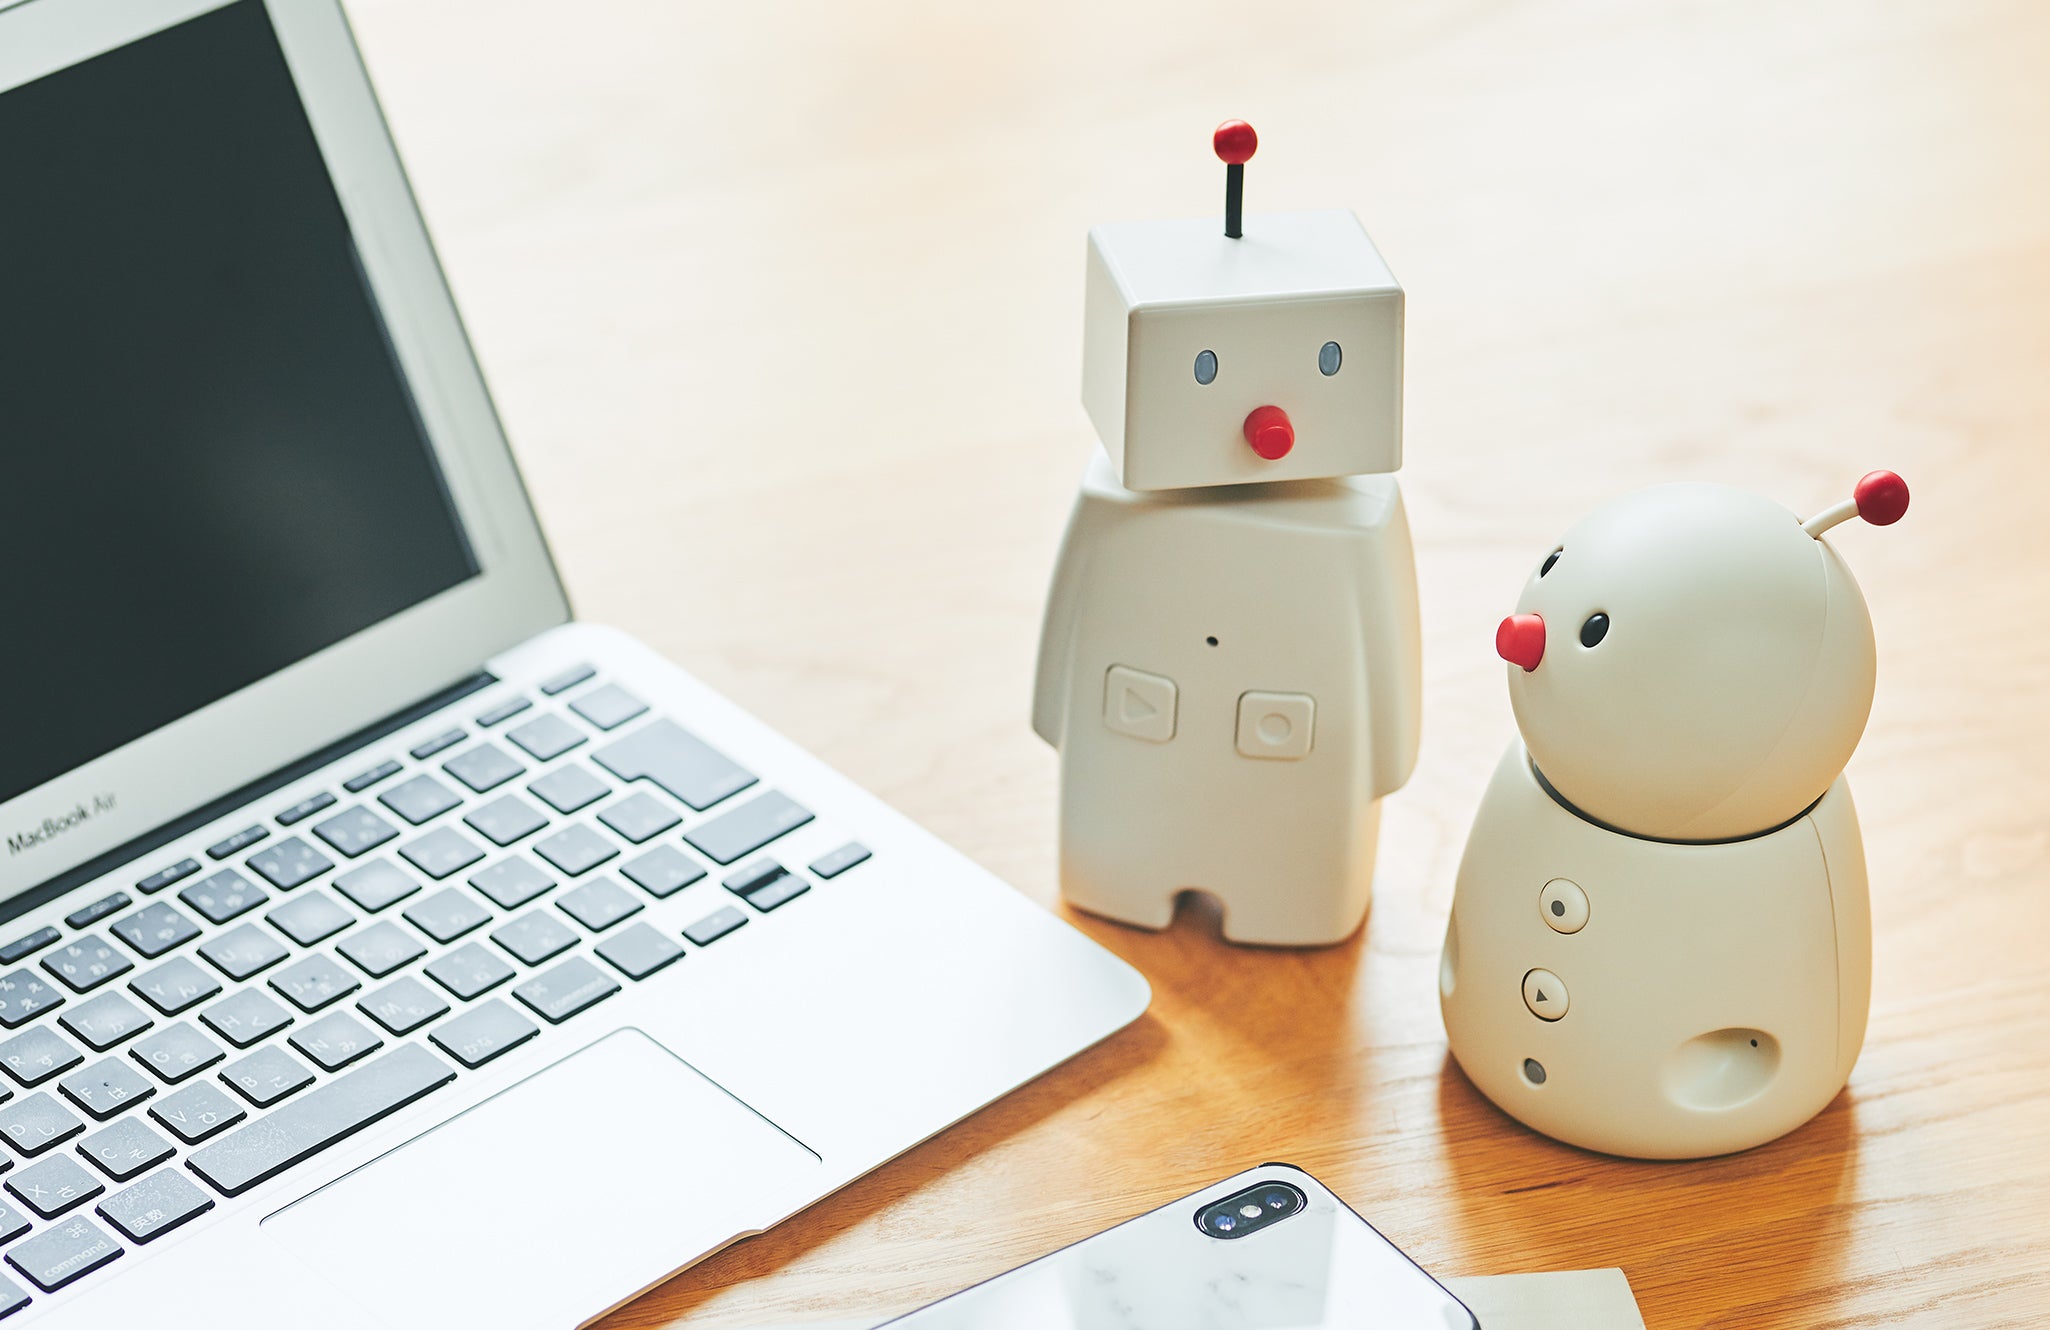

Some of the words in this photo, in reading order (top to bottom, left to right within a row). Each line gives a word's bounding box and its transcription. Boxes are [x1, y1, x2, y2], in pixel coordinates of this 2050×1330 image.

[7, 803, 89, 856] MacBook
[93, 792, 117, 814] Air
[219, 1015, 242, 1030] H
[308, 1039, 330, 1051] N
[7, 1055, 26, 1068] R
[152, 1050, 171, 1064] G
[240, 1076, 259, 1089] B
[79, 1086, 94, 1100] F
[107, 1086, 129, 1101] は
[169, 1109, 188, 1124] V
[197, 1111, 218, 1125] ひ
[8, 1123, 27, 1137] D
[36, 1126, 56, 1137] し
[100, 1147, 119, 1160] C
[27, 1184, 49, 1199] X
[129, 1208, 168, 1231] 英数
[43, 1239, 109, 1278] command
